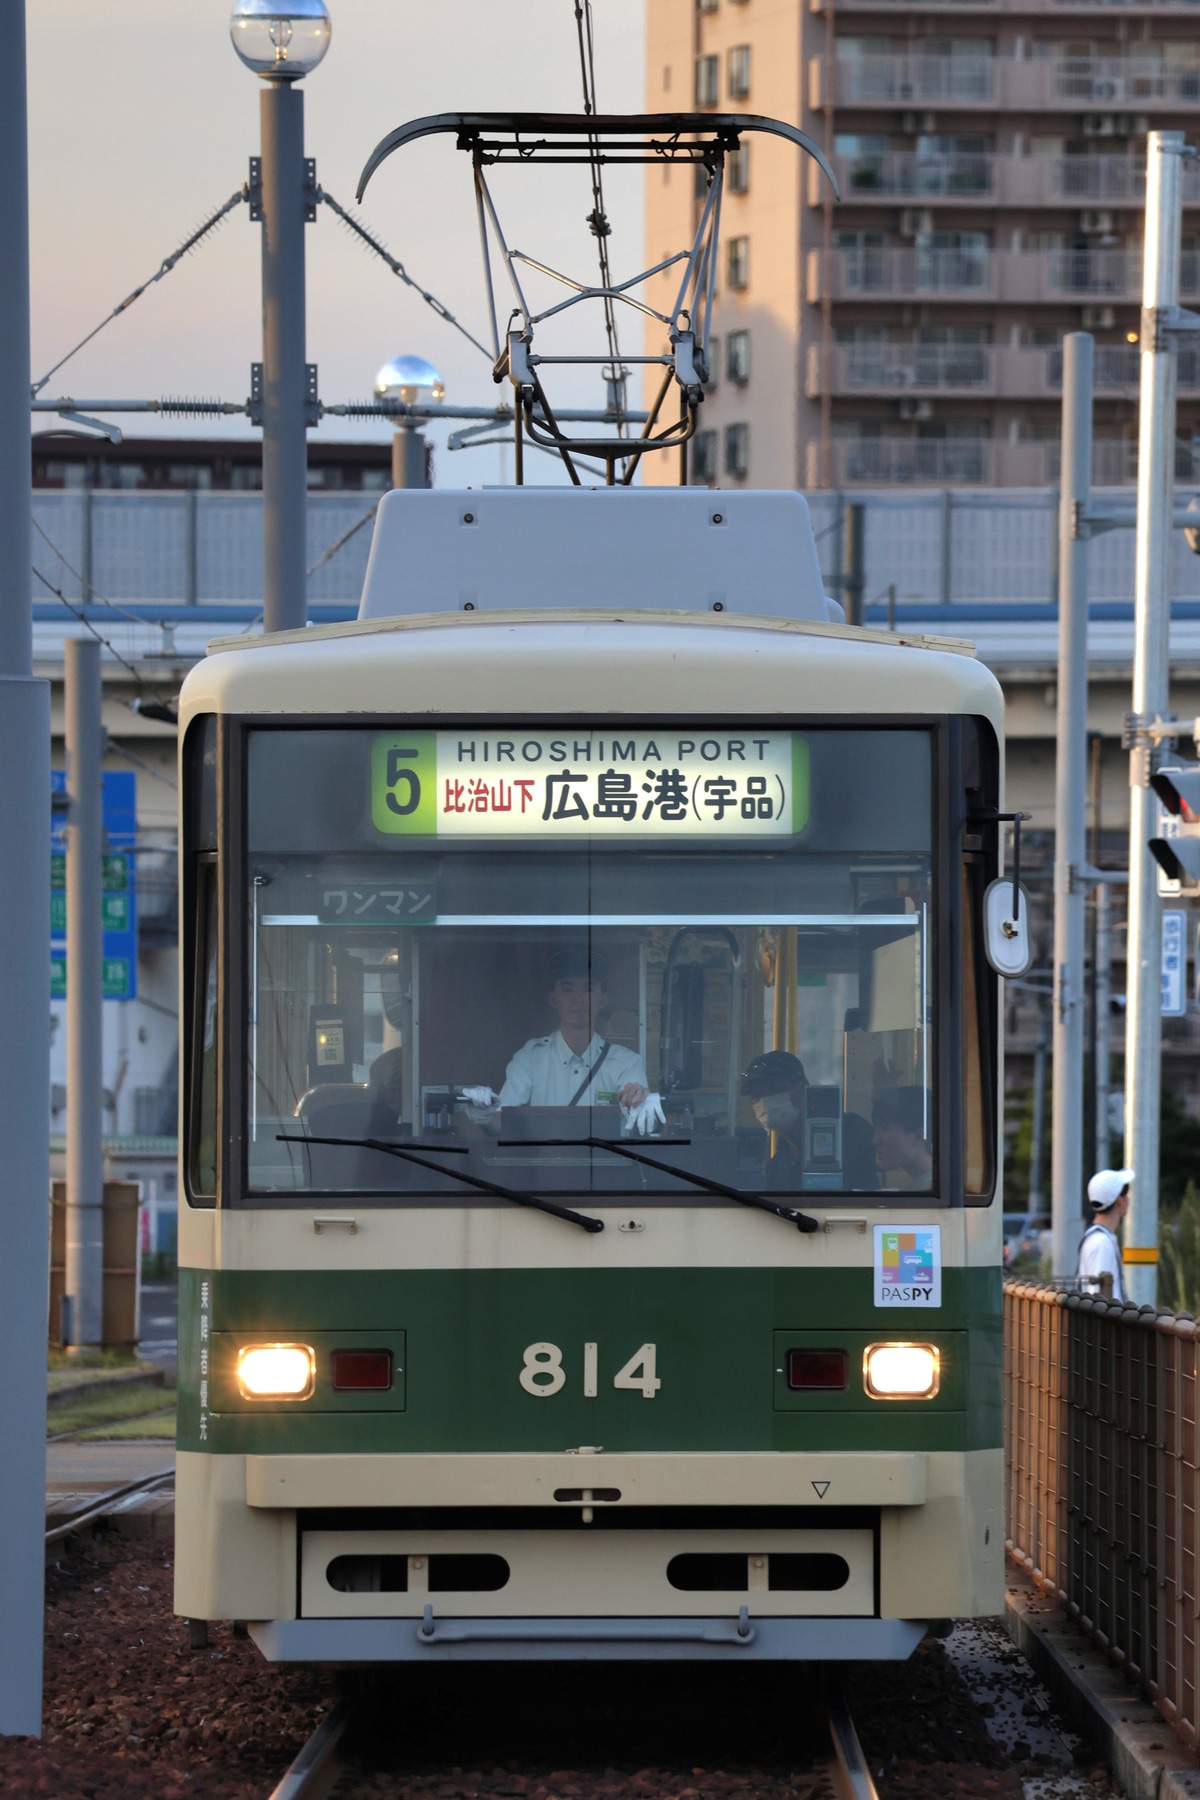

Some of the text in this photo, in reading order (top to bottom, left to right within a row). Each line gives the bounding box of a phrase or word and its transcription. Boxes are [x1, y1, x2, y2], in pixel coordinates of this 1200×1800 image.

[457, 740, 770, 762] HIROSHIMA PORT
[385, 748, 421, 815] 5
[443, 778, 535, 814] 比治山下
[323, 891, 431, 915] ワンマン
[881, 1287, 933, 1301] PASPY
[519, 1341, 661, 1398] 814
